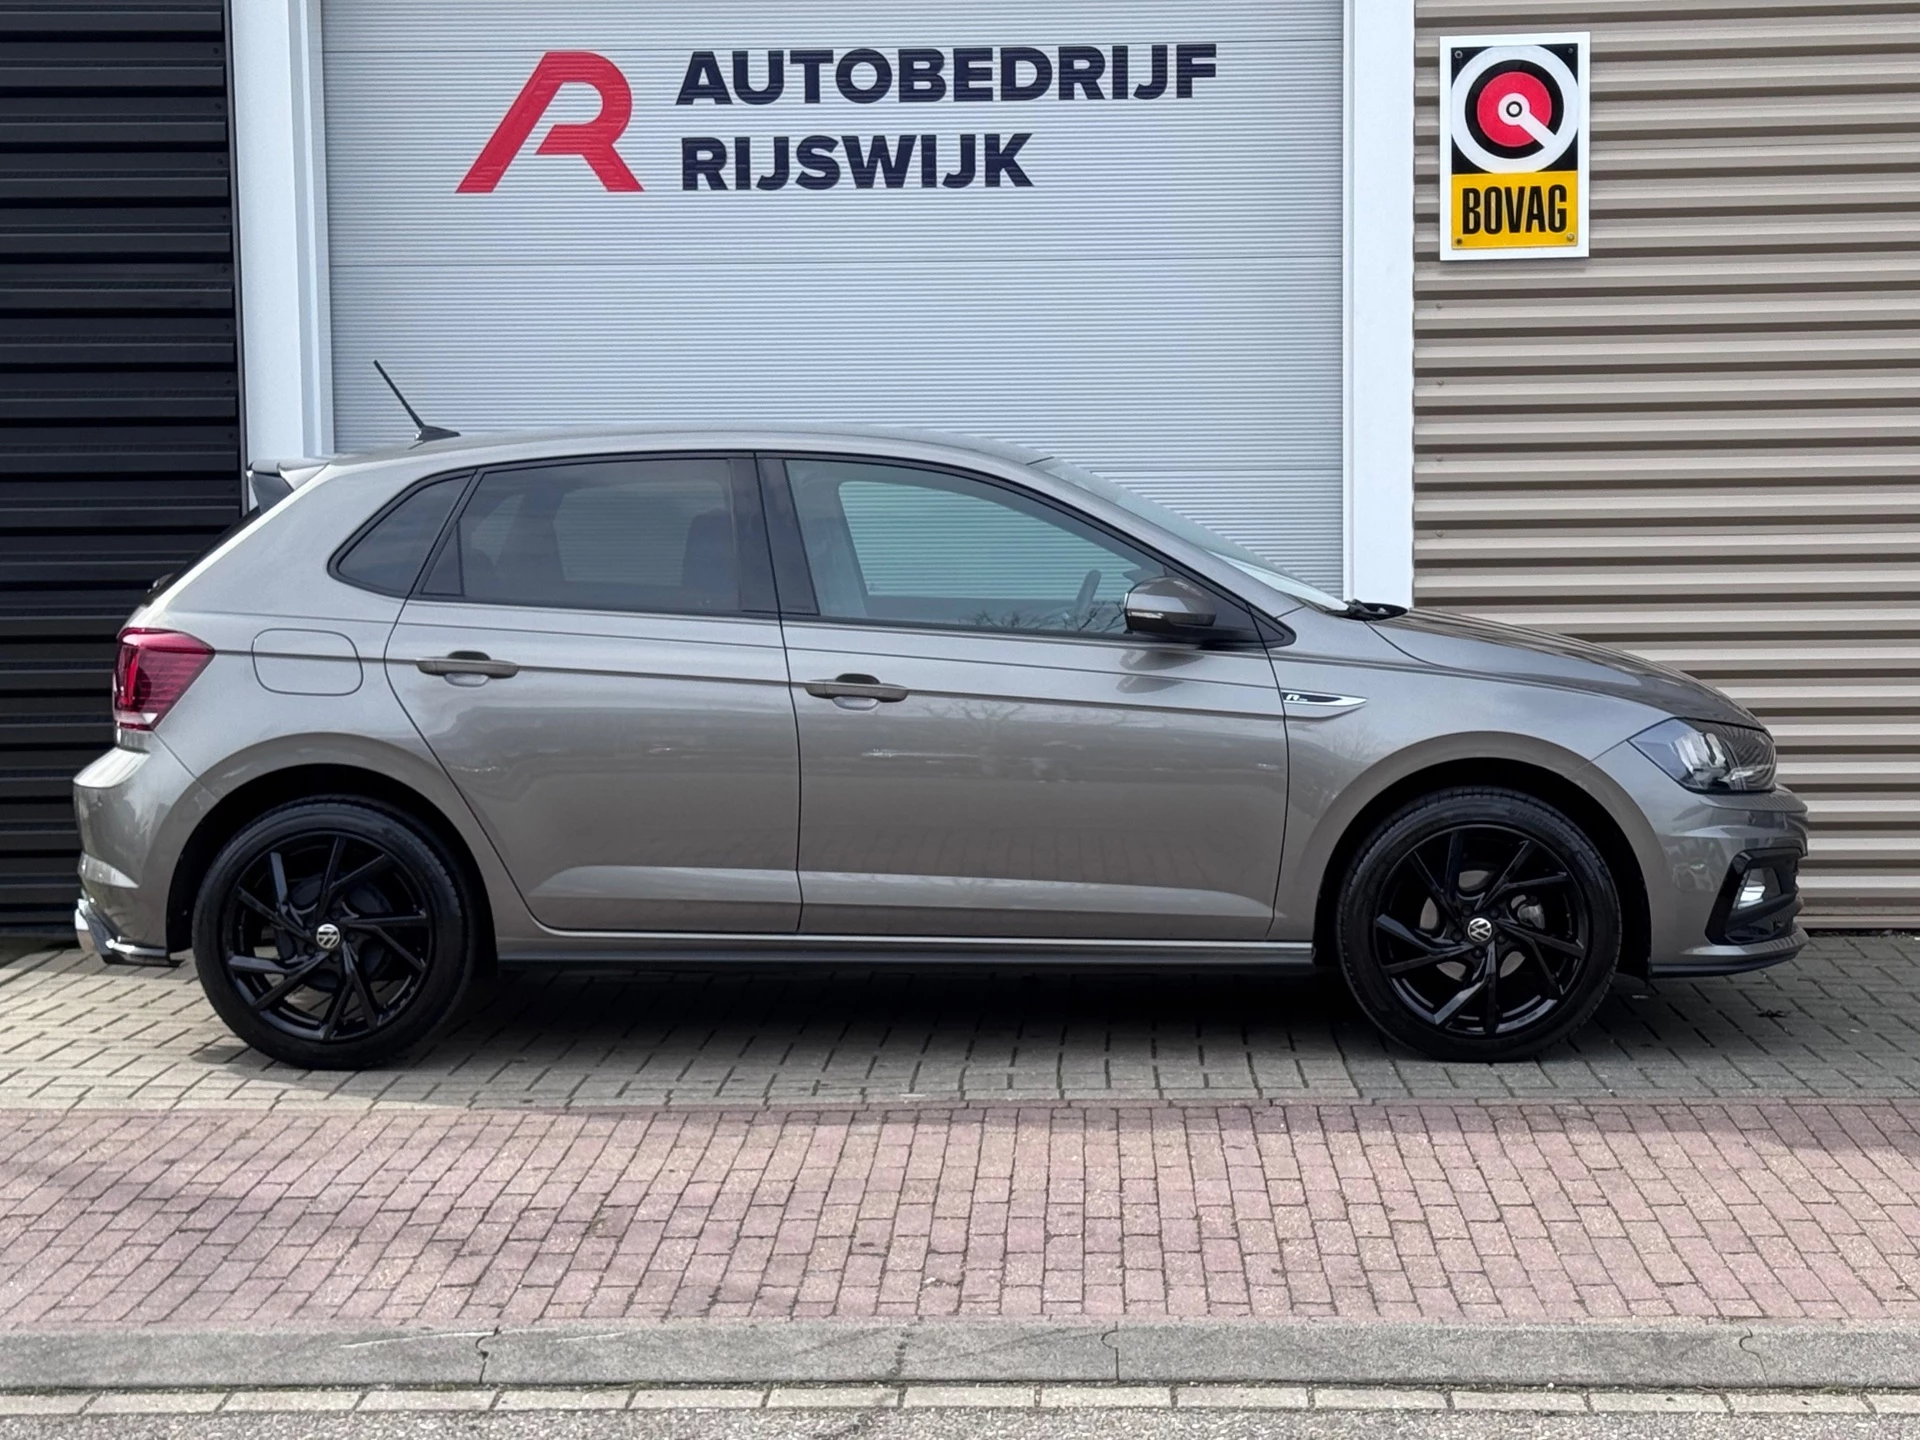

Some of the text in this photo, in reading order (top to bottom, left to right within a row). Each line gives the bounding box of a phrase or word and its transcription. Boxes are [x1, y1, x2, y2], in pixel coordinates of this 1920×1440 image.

[676, 44, 1217, 105] AUTOBEDRIJF
[681, 133, 1034, 191] RIJSWIJK
[1462, 184, 1567, 235] BOVAG
